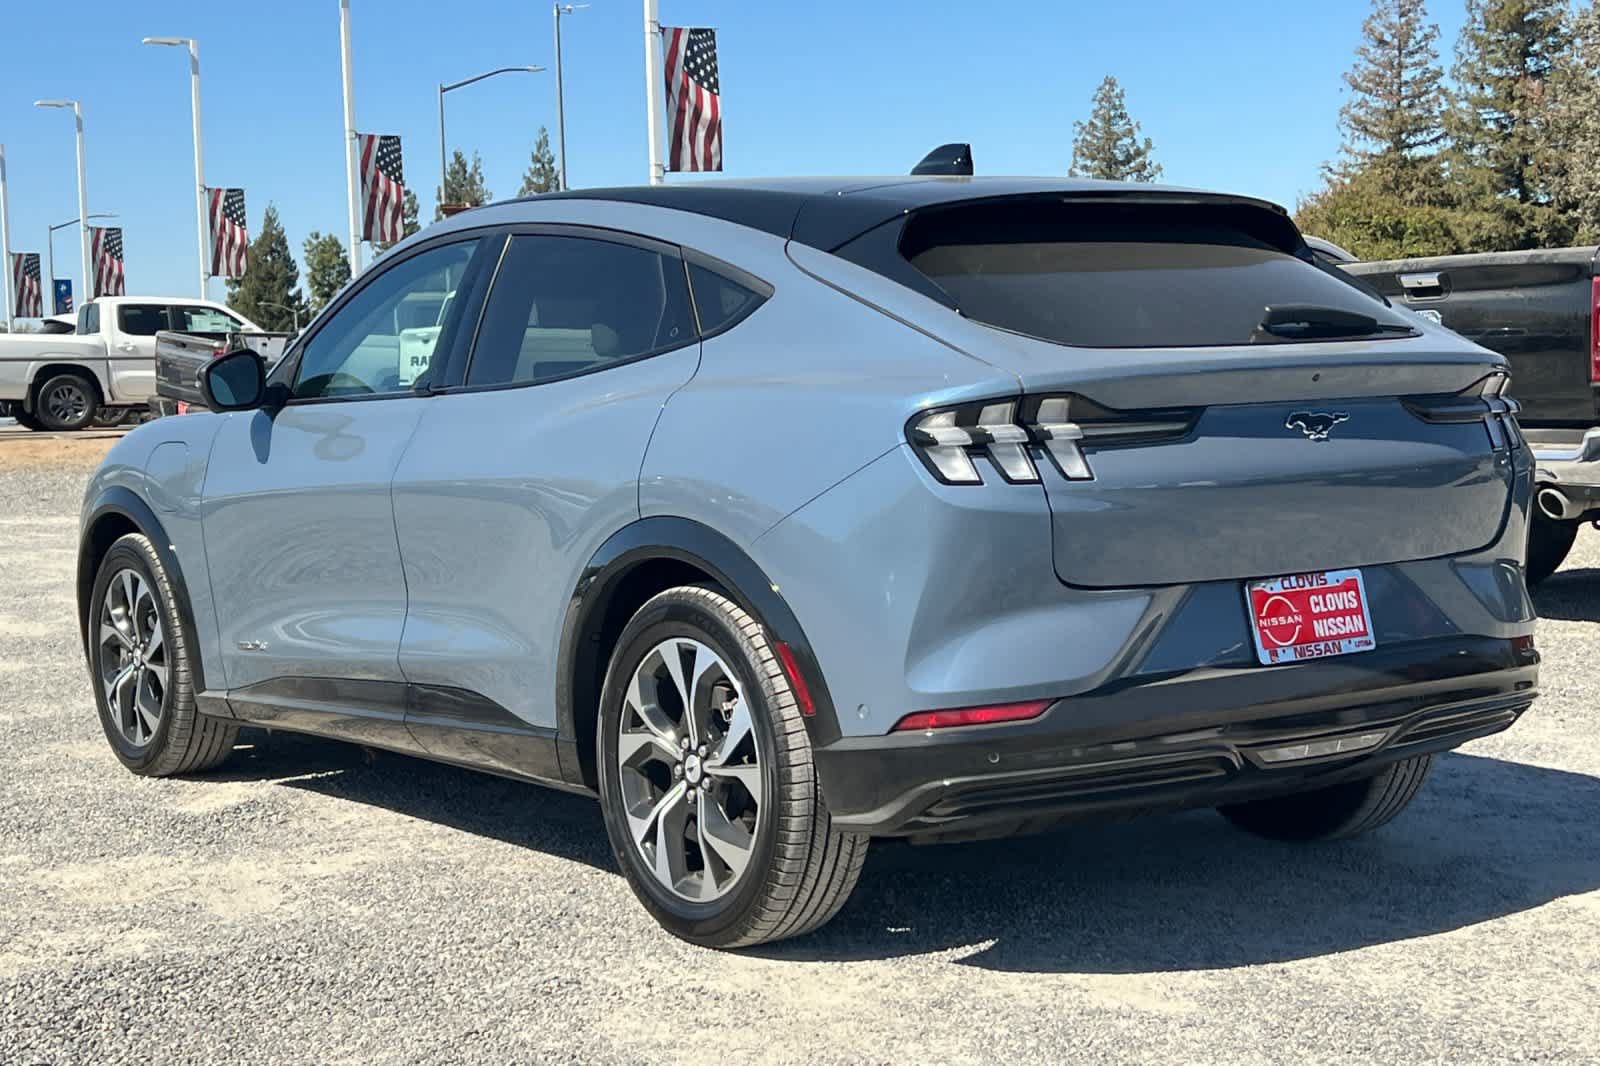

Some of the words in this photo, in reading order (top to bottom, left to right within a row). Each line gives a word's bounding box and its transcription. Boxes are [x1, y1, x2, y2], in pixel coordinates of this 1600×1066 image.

[410, 355, 433, 367] RA
[1281, 574, 1328, 589] CLOVIS
[1309, 591, 1358, 613] CLOVIS
[1259, 614, 1303, 628] NISSAN
[1313, 615, 1364, 638] NISSAN
[1293, 641, 1342, 659] NISSAN
